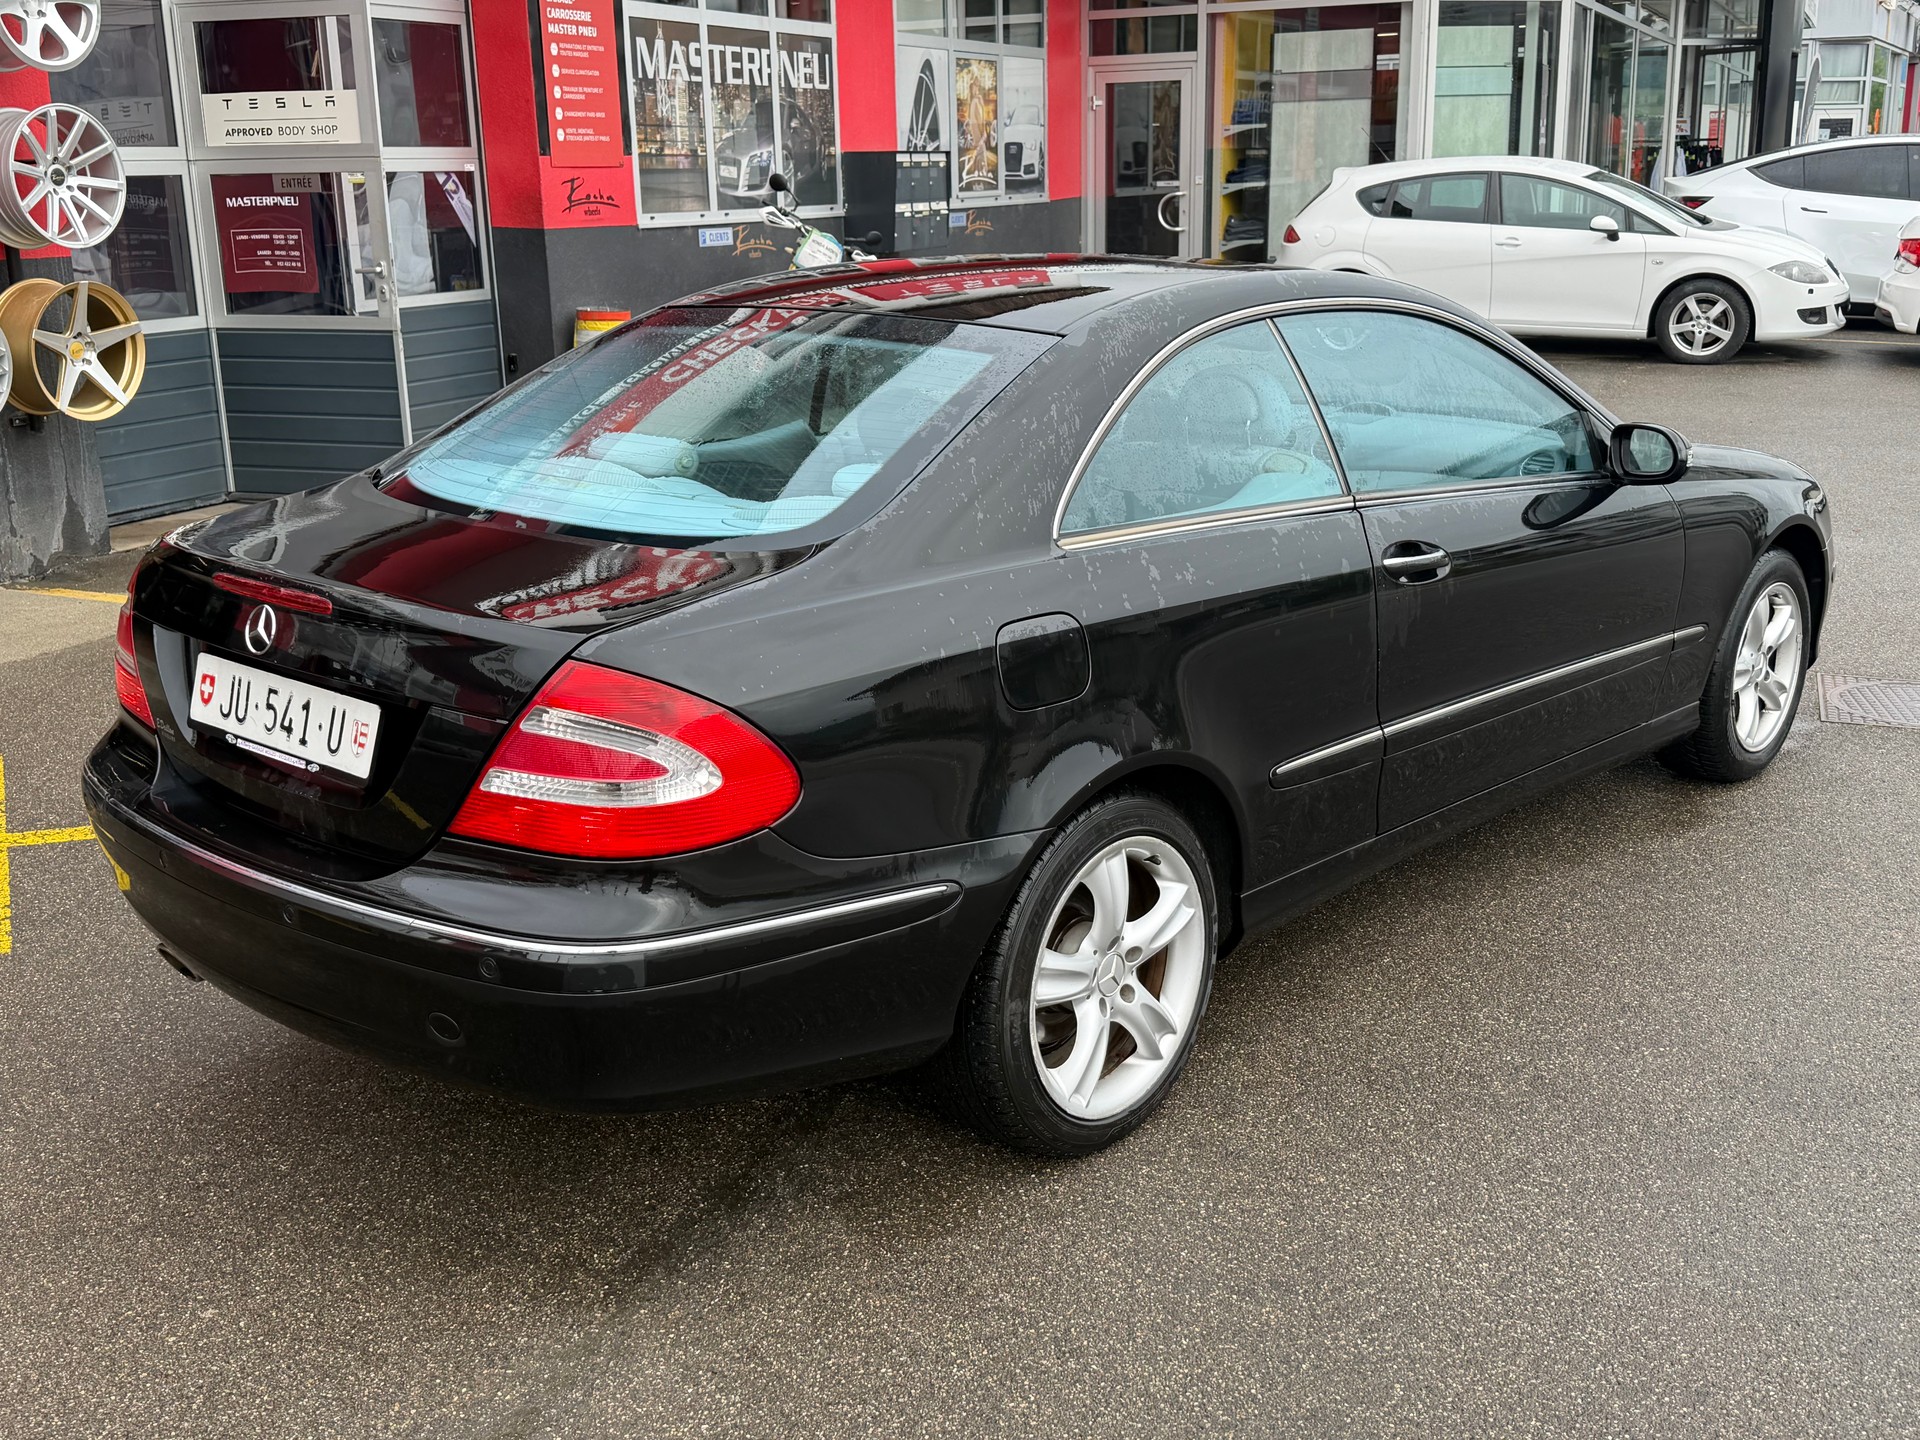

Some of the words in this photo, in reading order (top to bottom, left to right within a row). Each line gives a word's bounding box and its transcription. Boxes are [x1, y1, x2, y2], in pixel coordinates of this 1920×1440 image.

[546, 7, 592, 22] CARROSSERIE
[548, 23, 577, 35] MASTER
[578, 25, 597, 37] PNEU
[635, 36, 830, 90] MASTERPNEU
[222, 96, 336, 110] TESLA
[225, 128, 273, 137] APPROVED
[278, 126, 306, 136] BODY
[311, 125, 338, 134] SHOP
[281, 176, 312, 188] ENTRÉE
[226, 196, 299, 207] MASTERPNEU
[709, 231, 729, 242] CLIENTS
